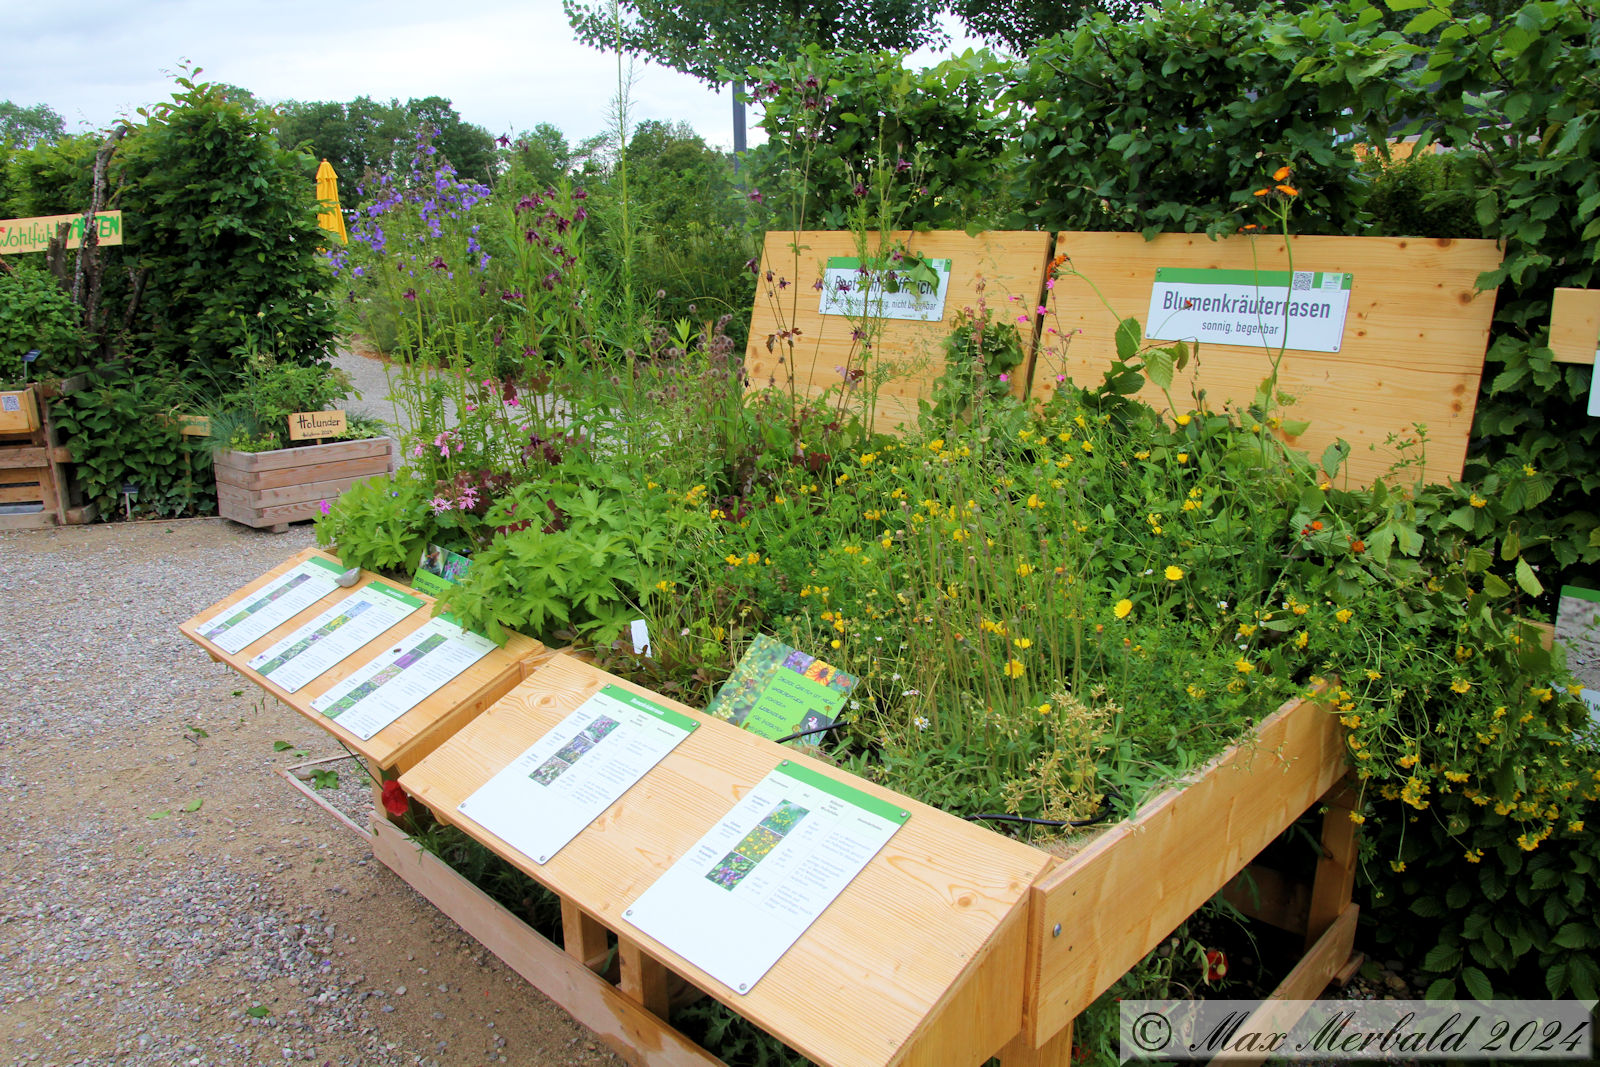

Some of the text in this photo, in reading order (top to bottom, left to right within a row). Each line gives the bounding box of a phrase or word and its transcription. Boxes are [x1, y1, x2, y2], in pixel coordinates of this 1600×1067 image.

[1163, 290, 1331, 318] Blumenkräuterrasen
[1235, 321, 1279, 336] begehbar
[297, 414, 341, 429] Holunder
